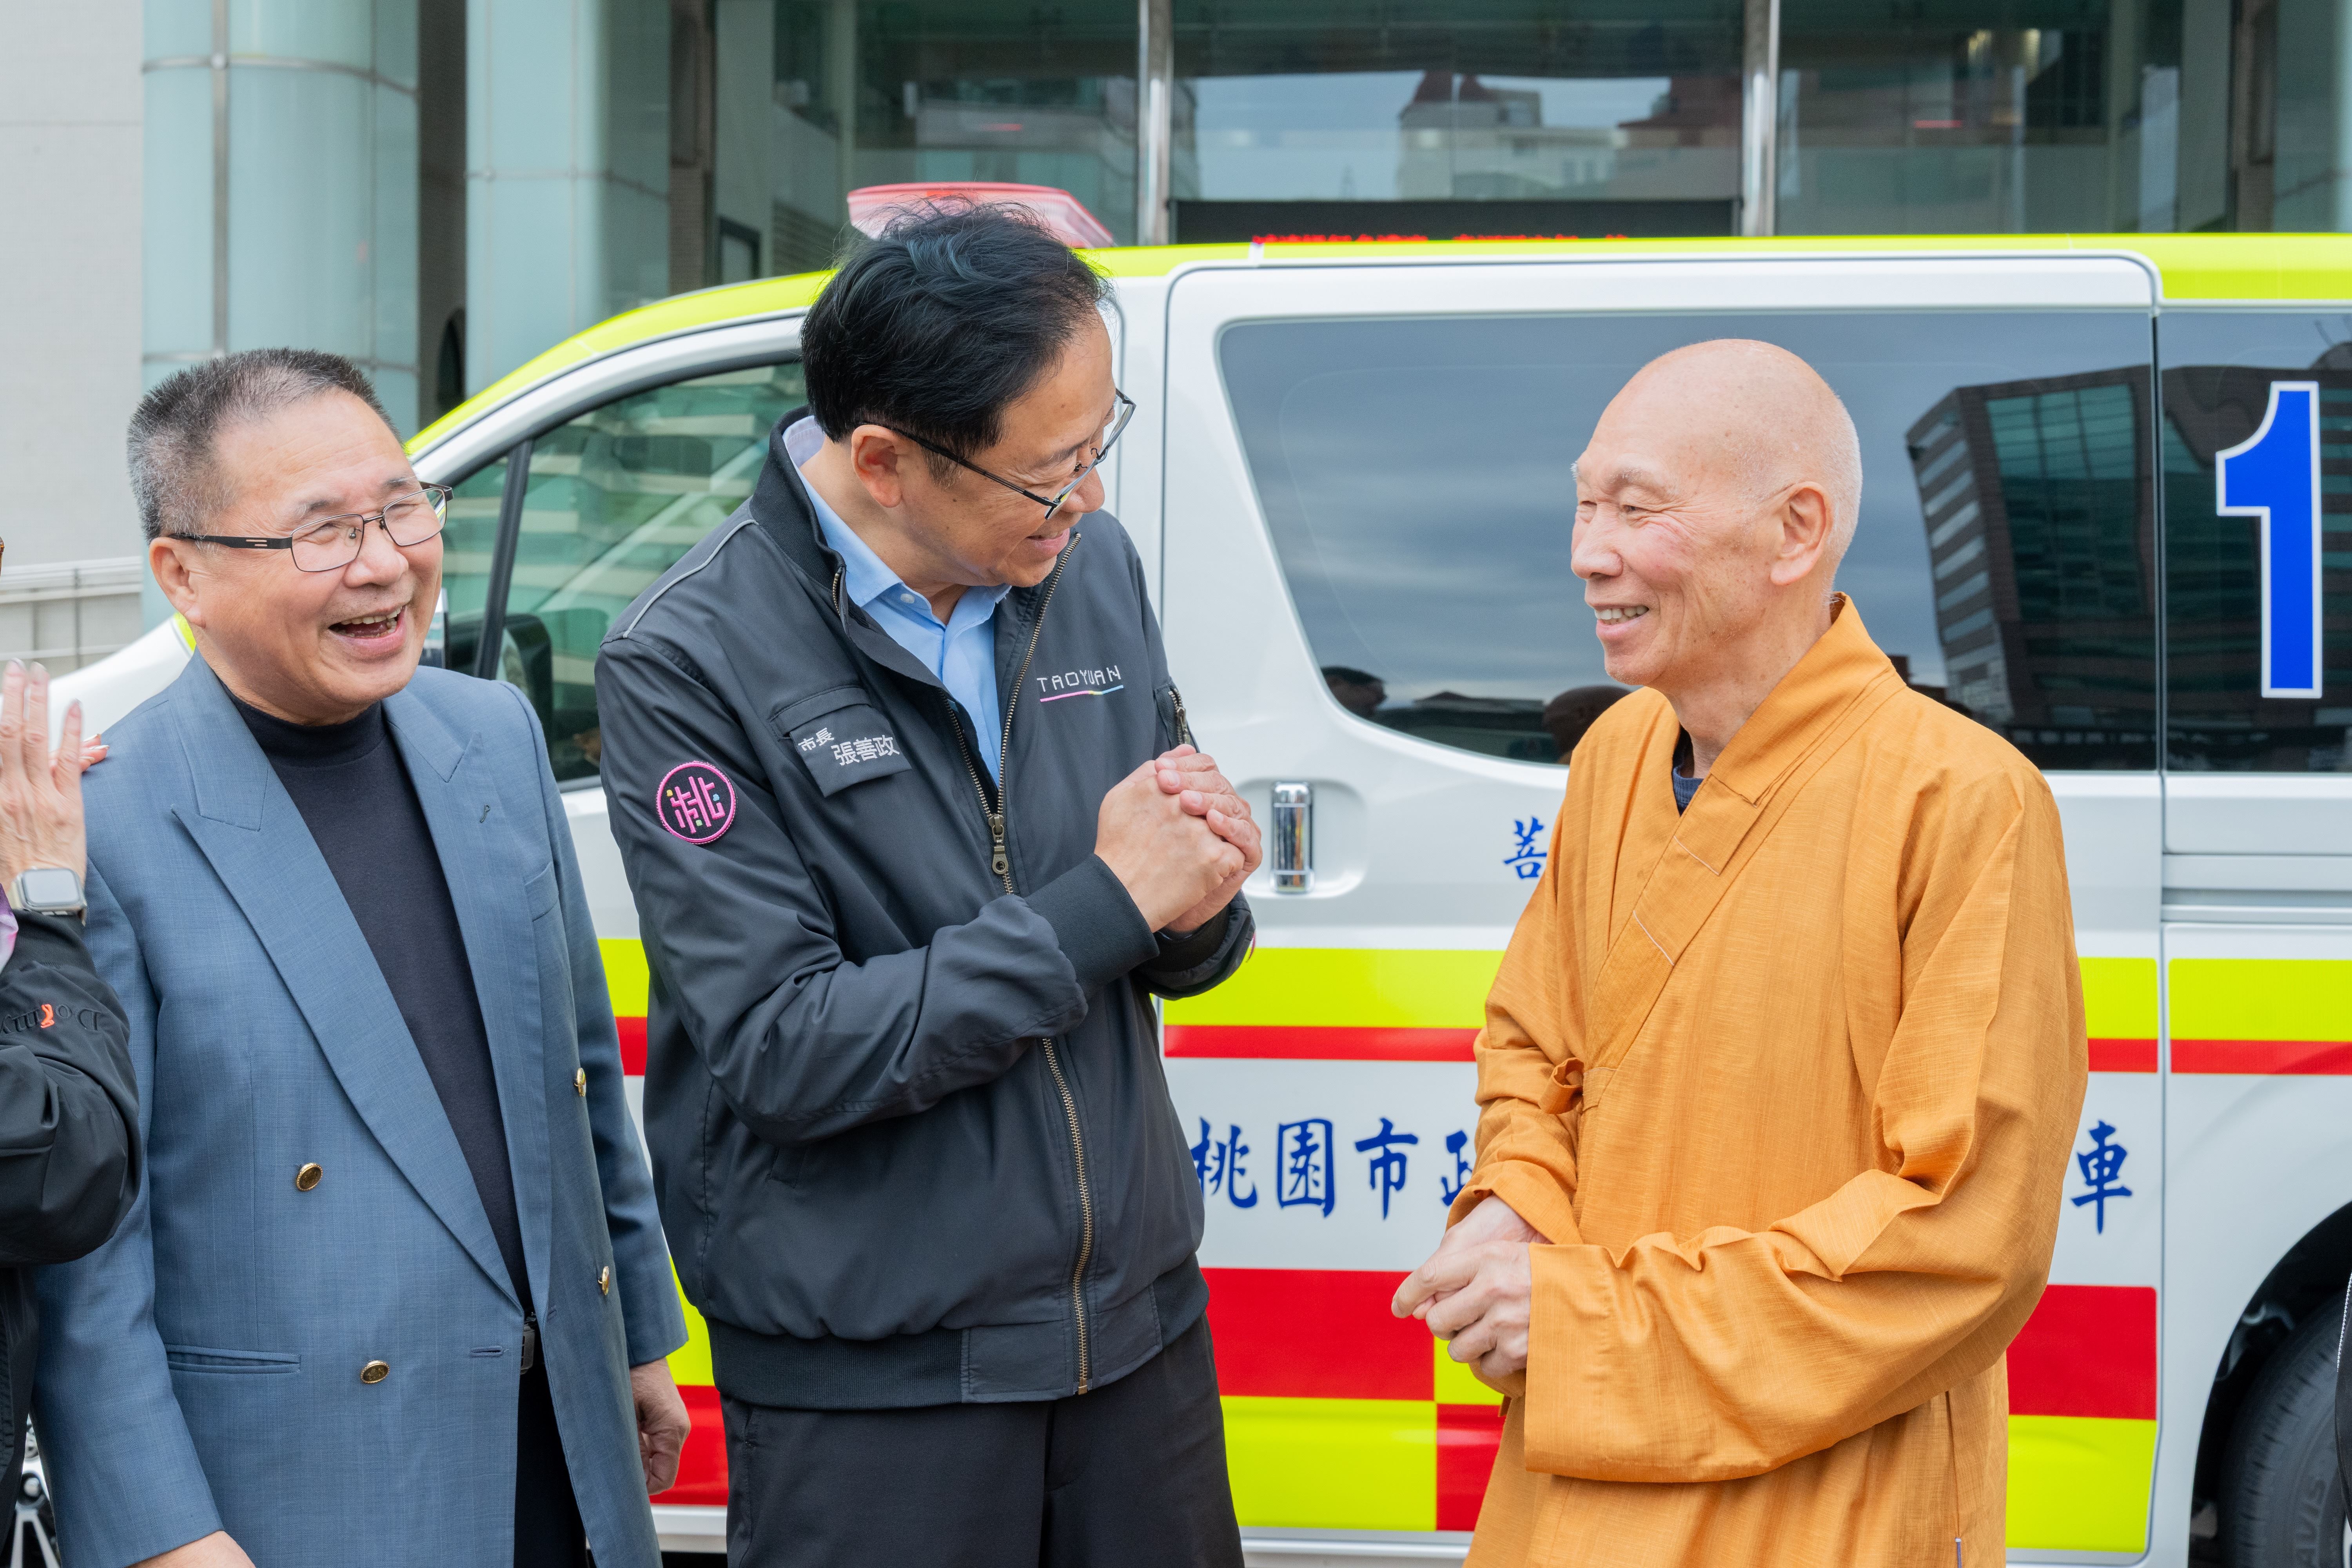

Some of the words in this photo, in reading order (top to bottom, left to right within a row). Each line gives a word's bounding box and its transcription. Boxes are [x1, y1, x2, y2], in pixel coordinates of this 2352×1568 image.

[2216, 381, 2322, 699] 1
[1037, 665, 1121, 692] TAOYUAN
[798, 727, 834, 751] 市長
[831, 735, 900, 766] 張善政
[1503, 817, 1547, 879] 菩
[2071, 1120, 2132, 1235] 車
